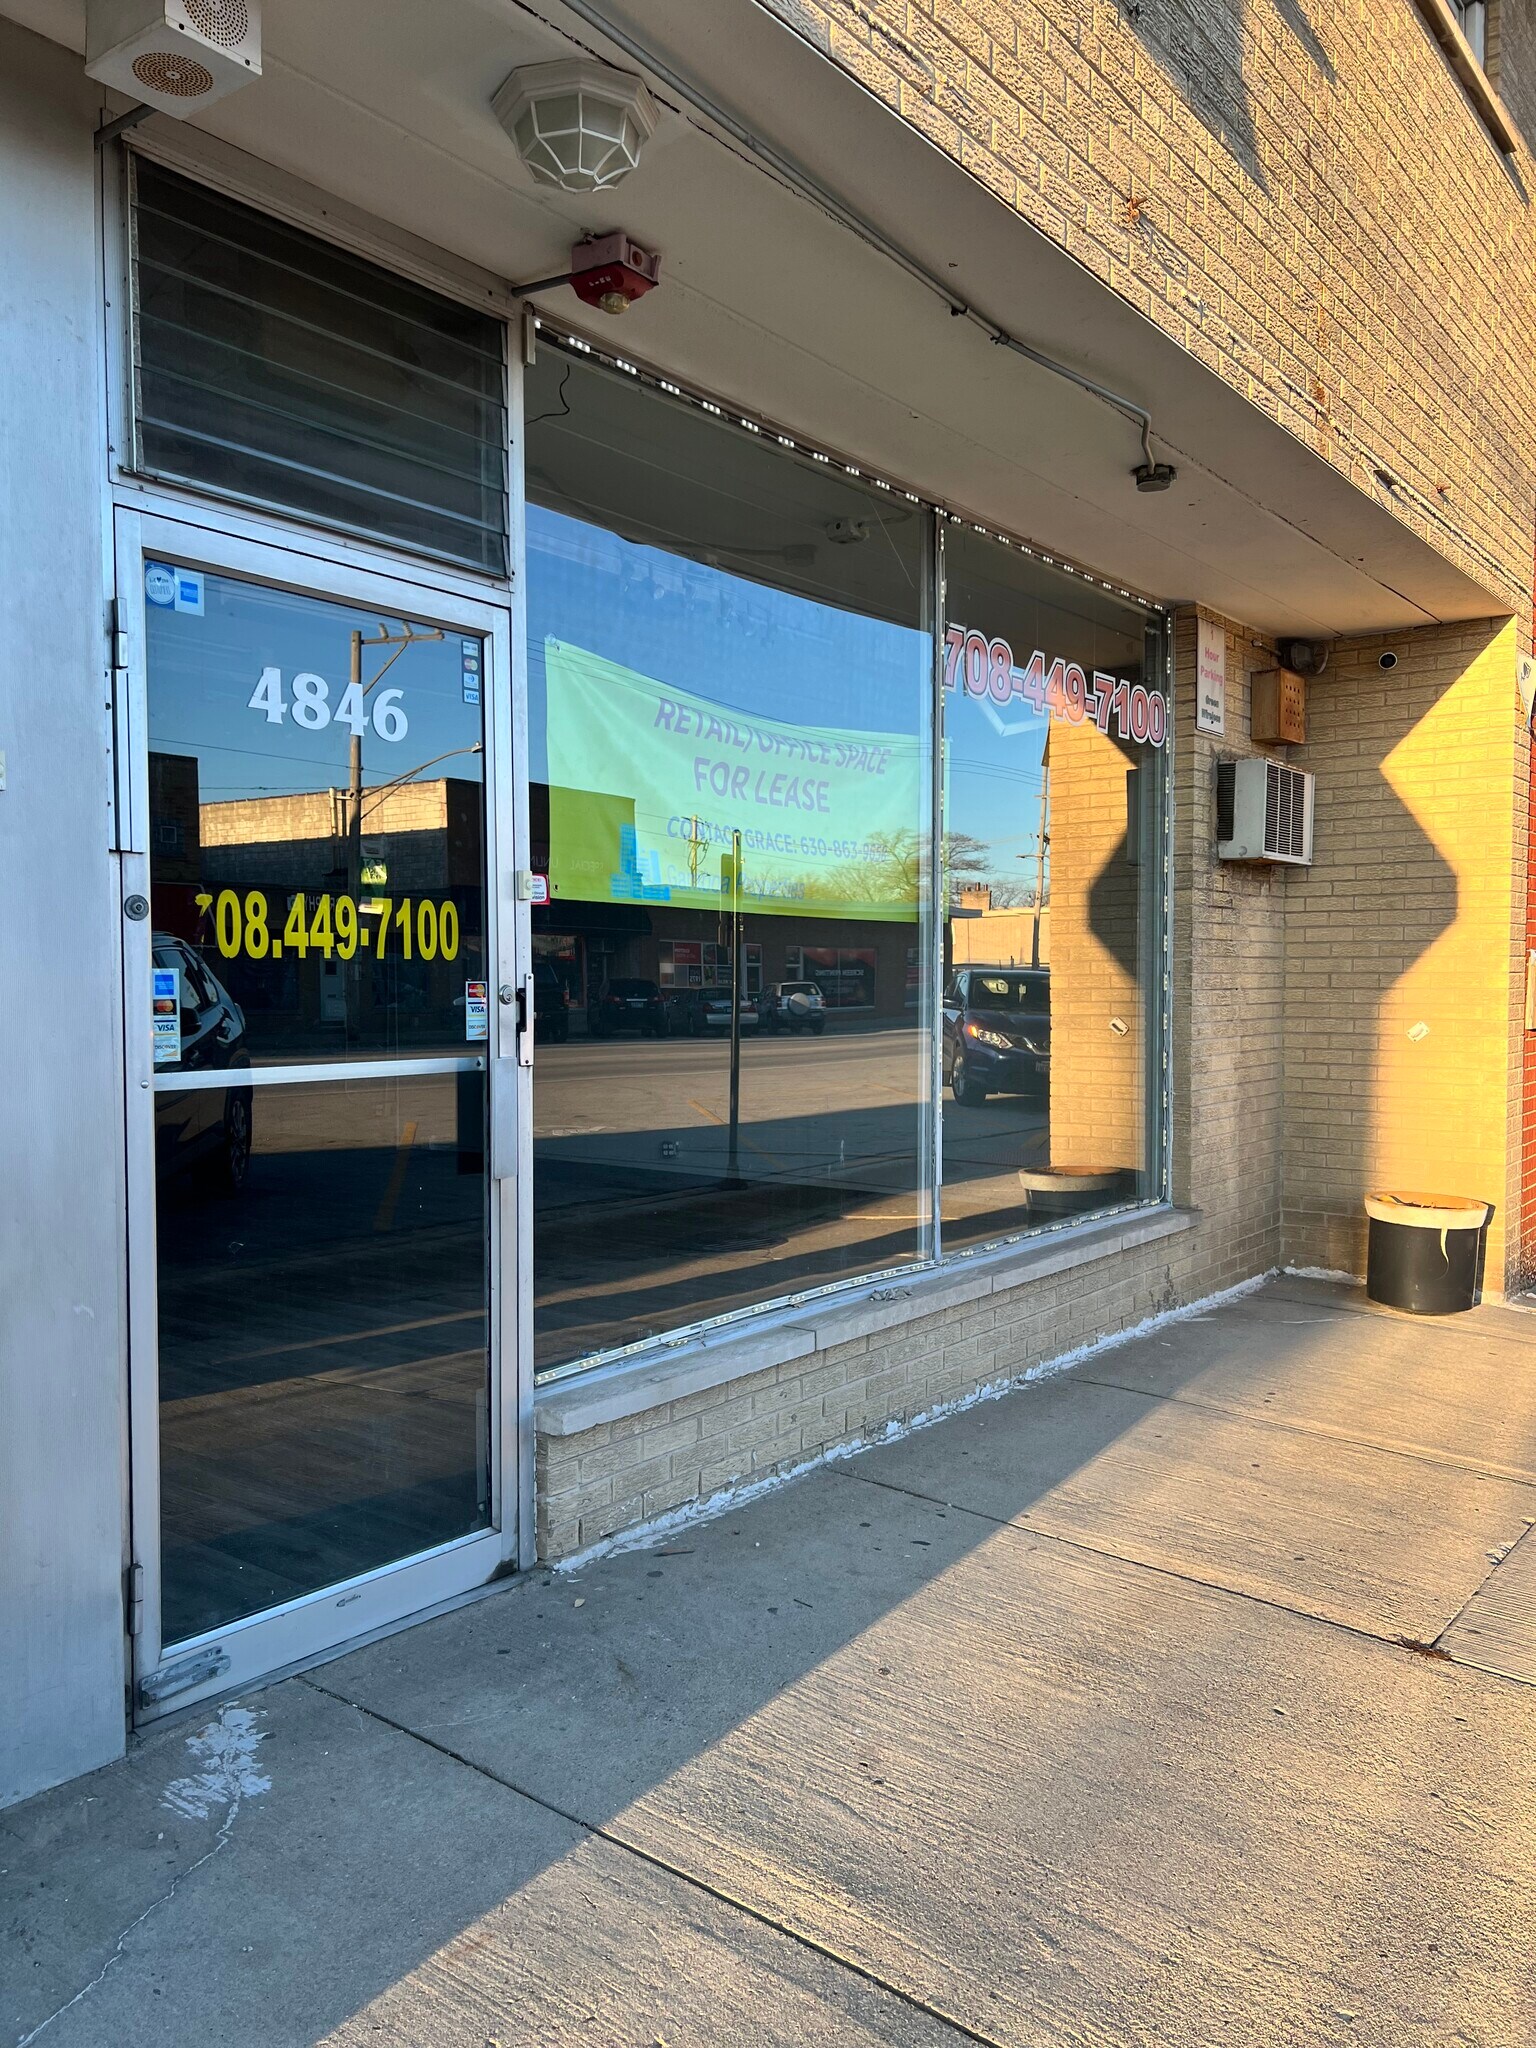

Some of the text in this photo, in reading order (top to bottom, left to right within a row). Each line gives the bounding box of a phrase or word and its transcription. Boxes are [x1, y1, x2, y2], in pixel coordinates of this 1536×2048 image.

[1204, 647, 1220, 663] Hour
[945, 622, 1167, 747] 708-449-7100
[1200, 665, 1223, 687] Parking
[247, 666, 408, 742] 4846
[465, 693, 479, 701] VISA
[834, 742, 892, 775] SPACE
[693, 756, 831, 813] FOR LEASE
[745, 829, 798, 854] GRACE:
[470, 1005, 484, 1013] VISA
[157, 1024, 175, 1032] VISA
